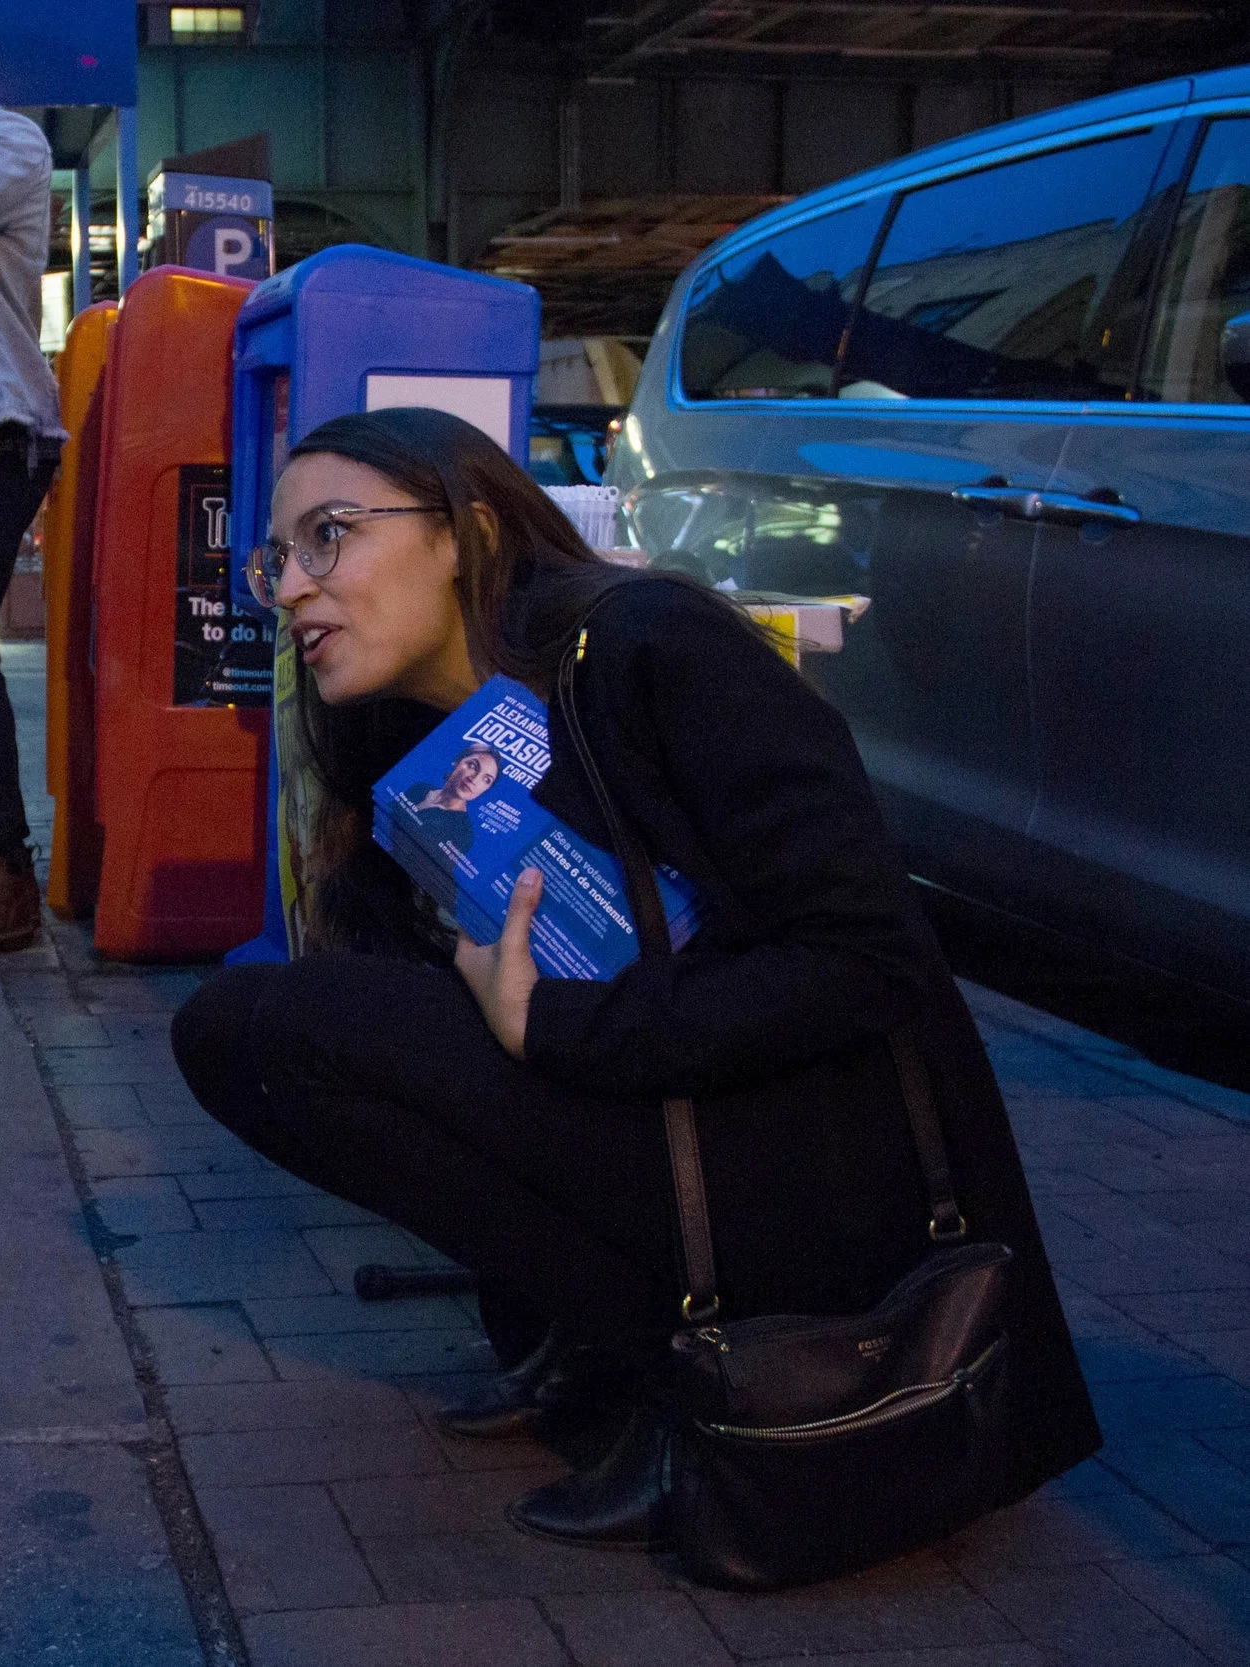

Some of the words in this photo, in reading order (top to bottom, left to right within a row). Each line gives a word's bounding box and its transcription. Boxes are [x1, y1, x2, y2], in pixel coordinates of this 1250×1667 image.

[184, 191, 252, 212] 415540
[215, 228, 253, 275] P
[188, 597, 225, 616] The
[202, 623, 224, 642] to
[231, 623, 256, 642] do
[213, 680, 271, 692] timeout.com
[493, 703, 549, 741] ALEXANDR
[570, 849, 584, 863] un
[541, 839, 571, 870] martes
[570, 868, 580, 877] 6
[577, 875, 590, 889] de
[588, 888, 633, 934] noviembre
